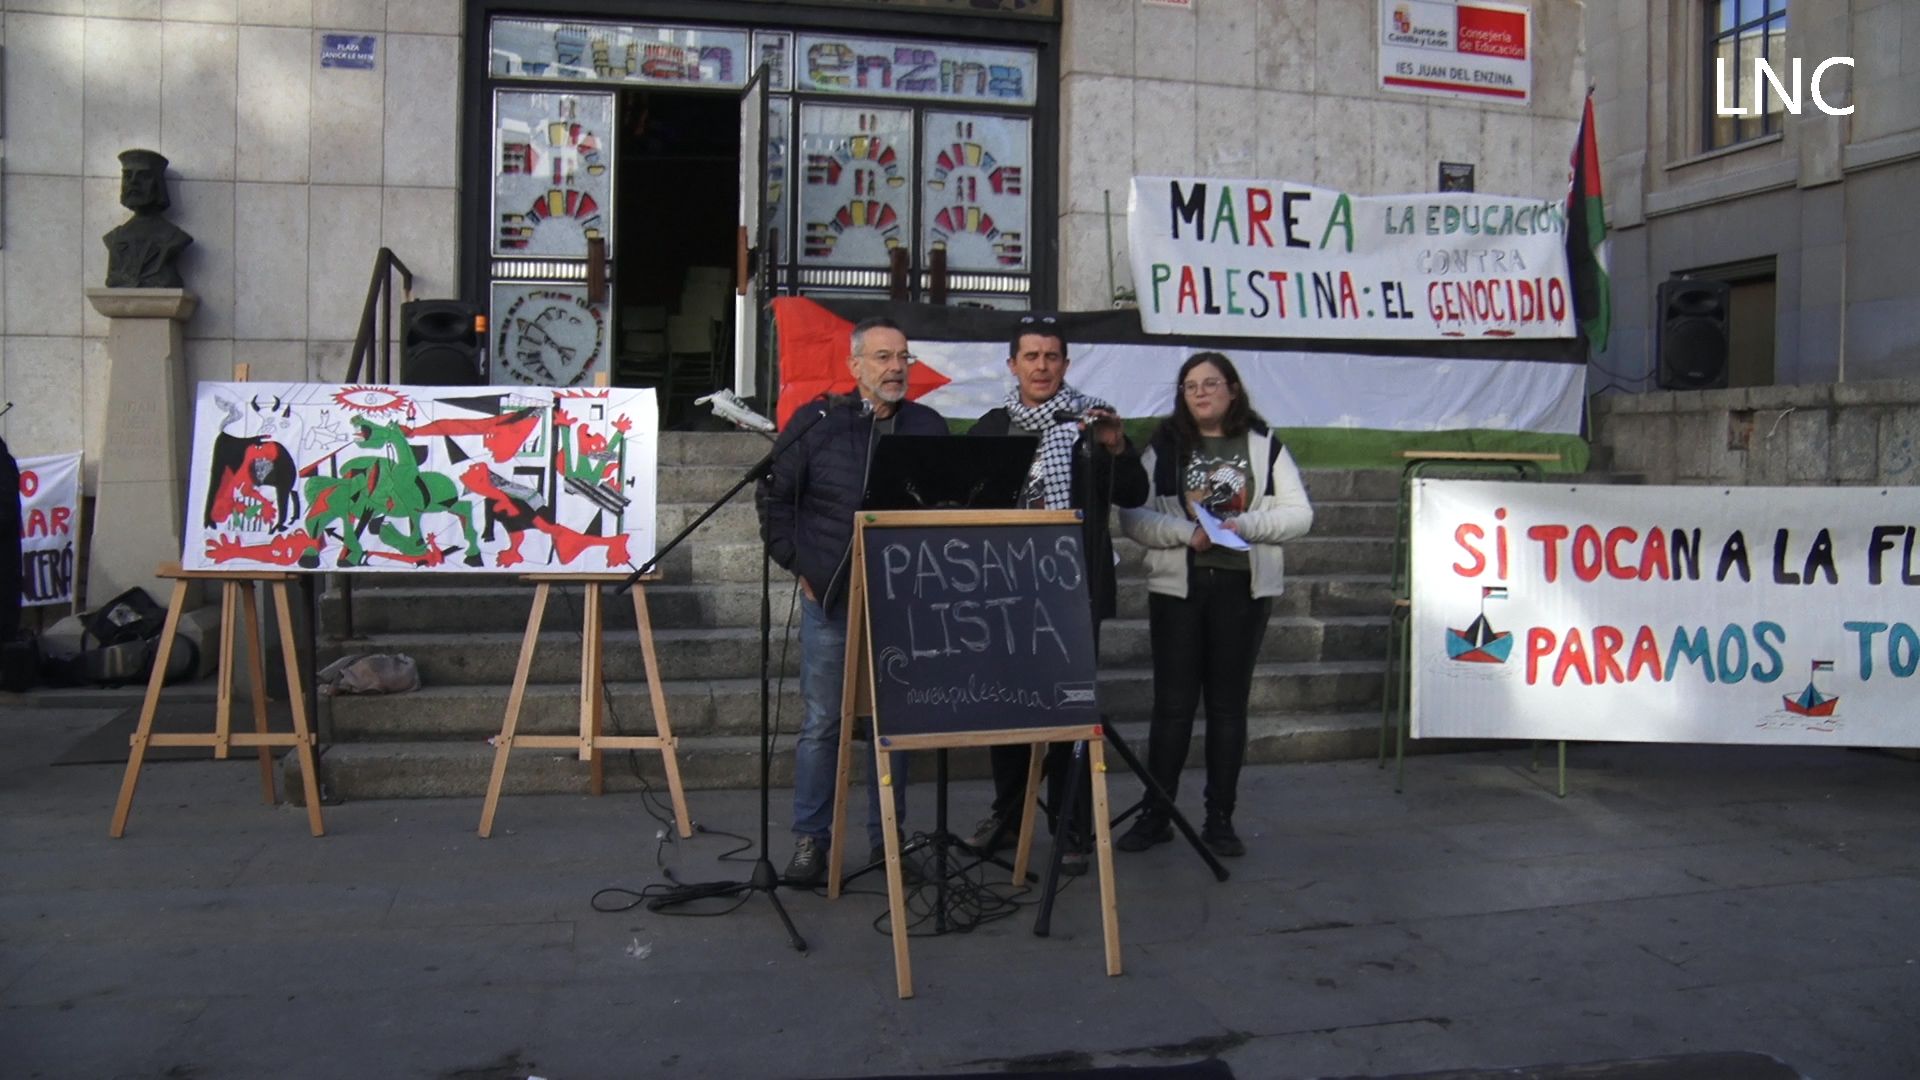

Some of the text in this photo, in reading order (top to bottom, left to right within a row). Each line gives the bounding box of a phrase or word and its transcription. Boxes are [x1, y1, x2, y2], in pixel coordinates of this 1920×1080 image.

[1388, 33, 1419, 44] Castilla
[1412, 27, 1448, 37] Junta de
[1460, 27, 1512, 45] Consejería
[1460, 40, 1524, 56] de Educación
[1396, 62, 1513, 85] IES JUAN DEL ENZINA
[1170, 180, 1354, 253] MAREA
[1385, 205, 1415, 235] LA
[1416, 249, 1527, 275] CONTRA
[1381, 281, 1414, 319] EL
[1427, 276, 1567, 325] GENOCIDIO
[20, 507, 71, 538] AR
[1527, 523, 1702, 584] TOCAN
[1716, 529, 1751, 583] A
[1773, 527, 1839, 586] LA
[907, 596, 1071, 664] LISTA
[1525, 621, 1920, 687] PARAMOS TO
